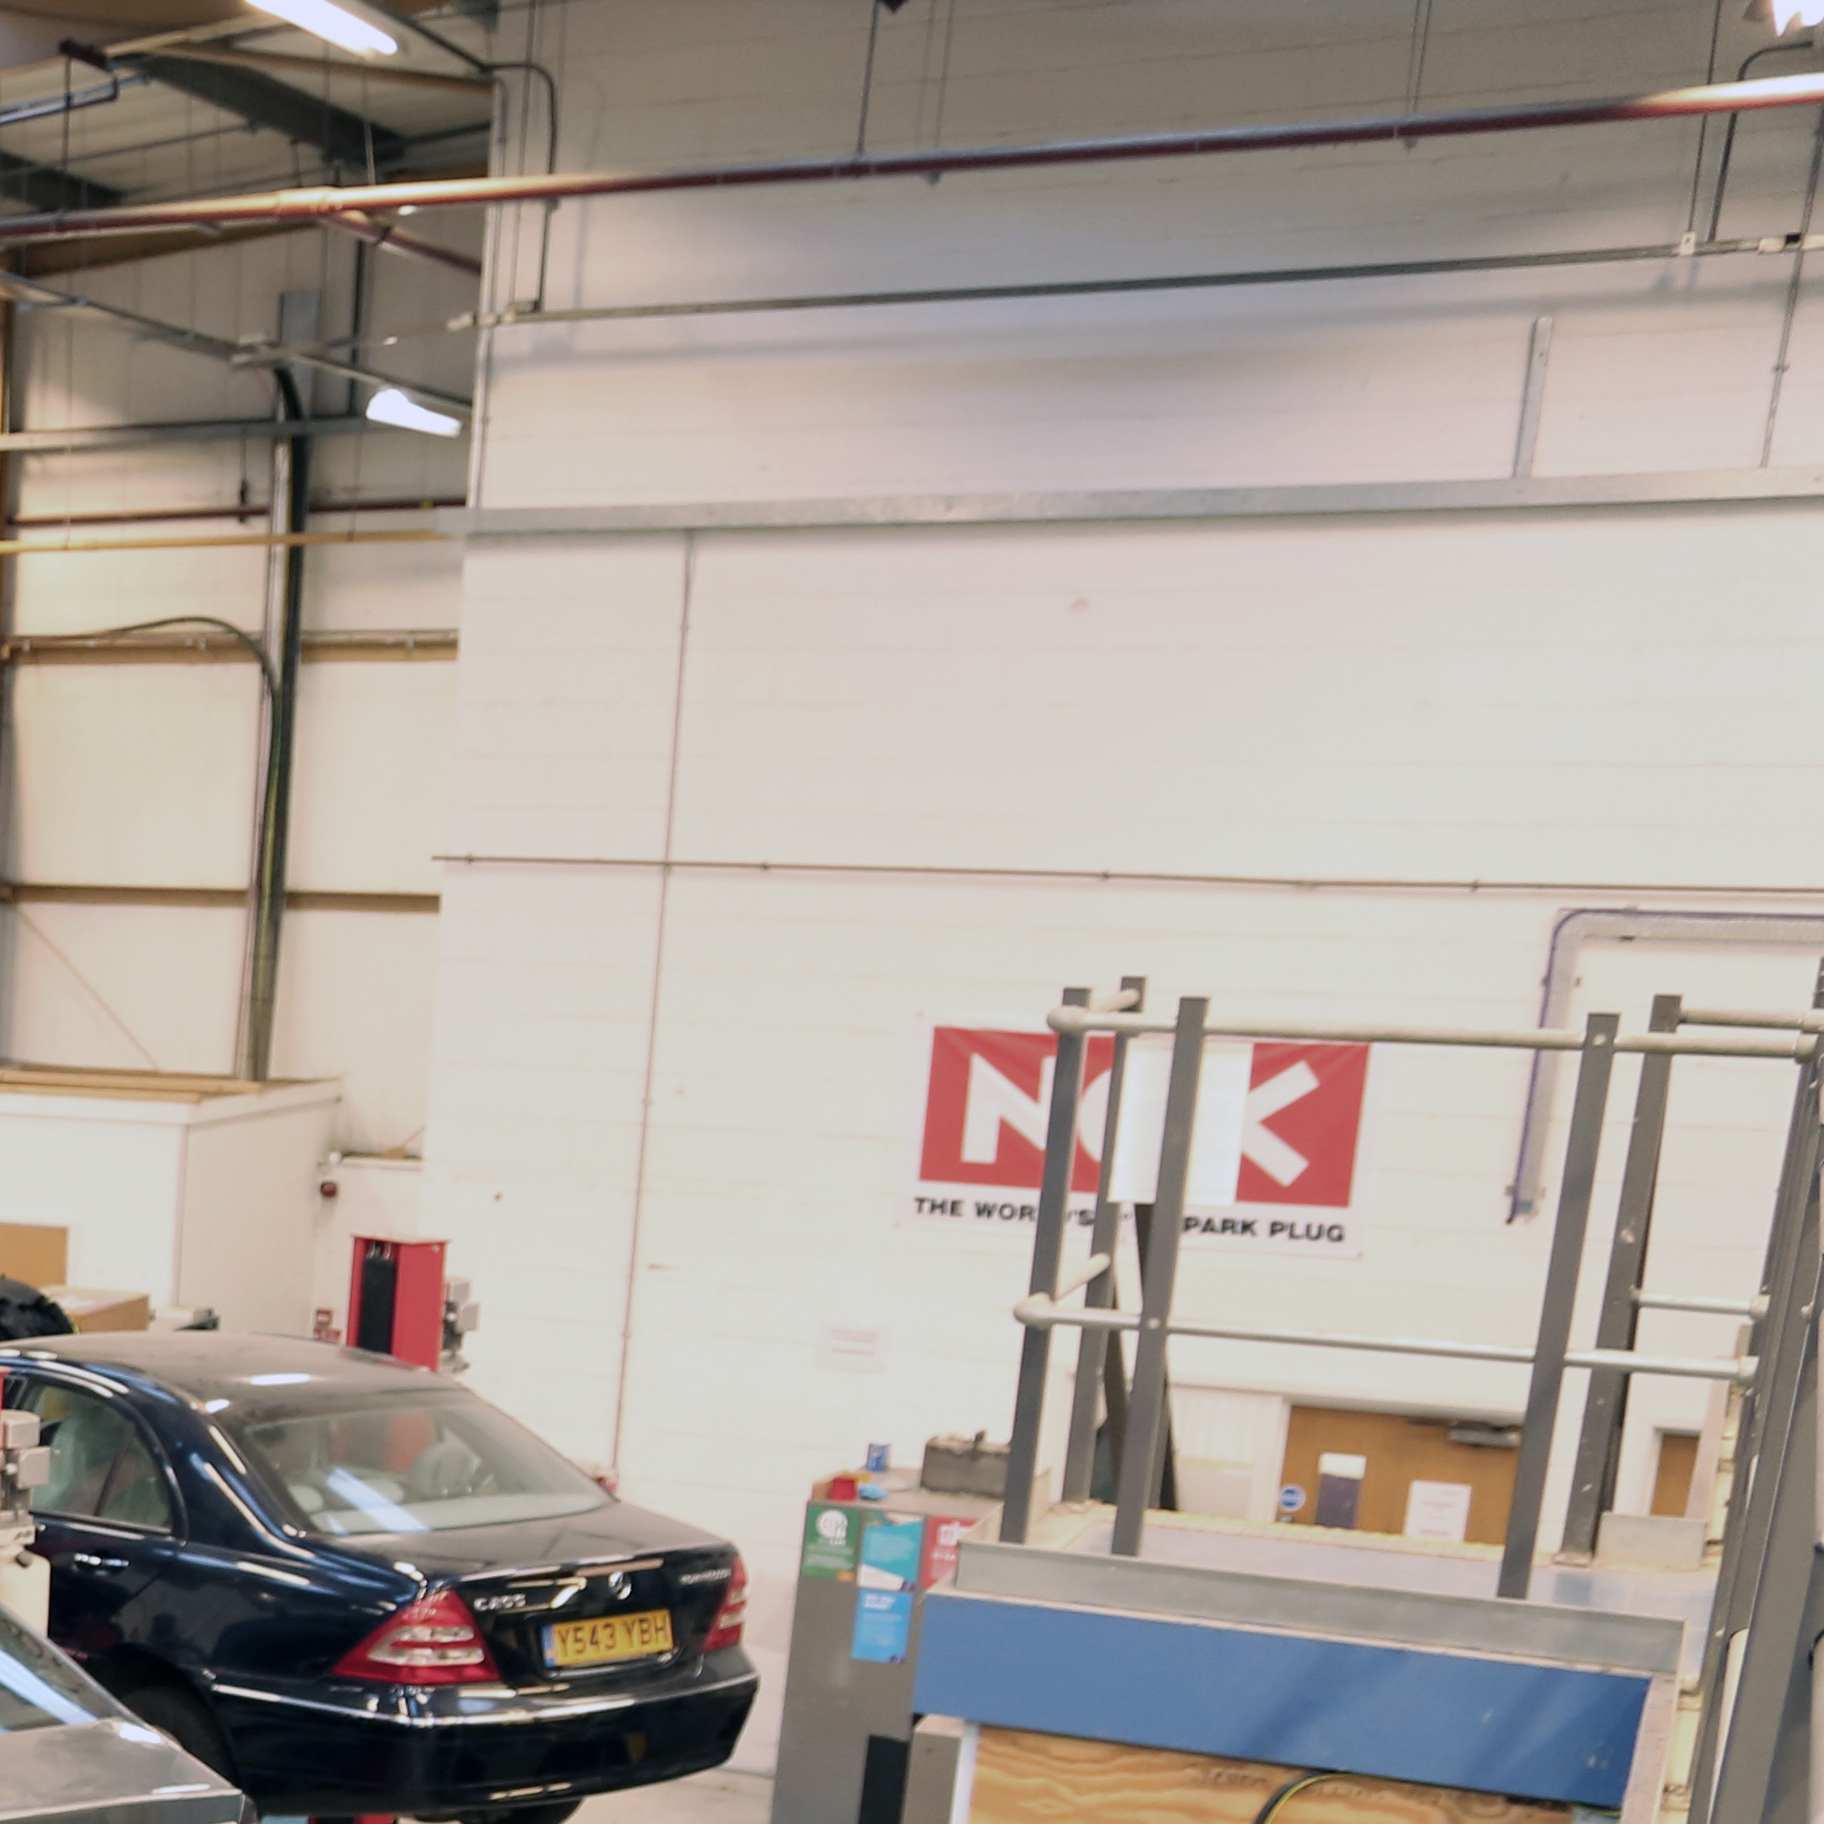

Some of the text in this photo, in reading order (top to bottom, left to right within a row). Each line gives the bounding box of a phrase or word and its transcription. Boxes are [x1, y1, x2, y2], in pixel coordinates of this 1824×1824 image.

[960, 1051, 1321, 1188] NK
[915, 1196, 964, 1218] THE
[1269, 1218, 1347, 1244] PLUG
[557, 1613, 671, 1659] Y543 YBH
